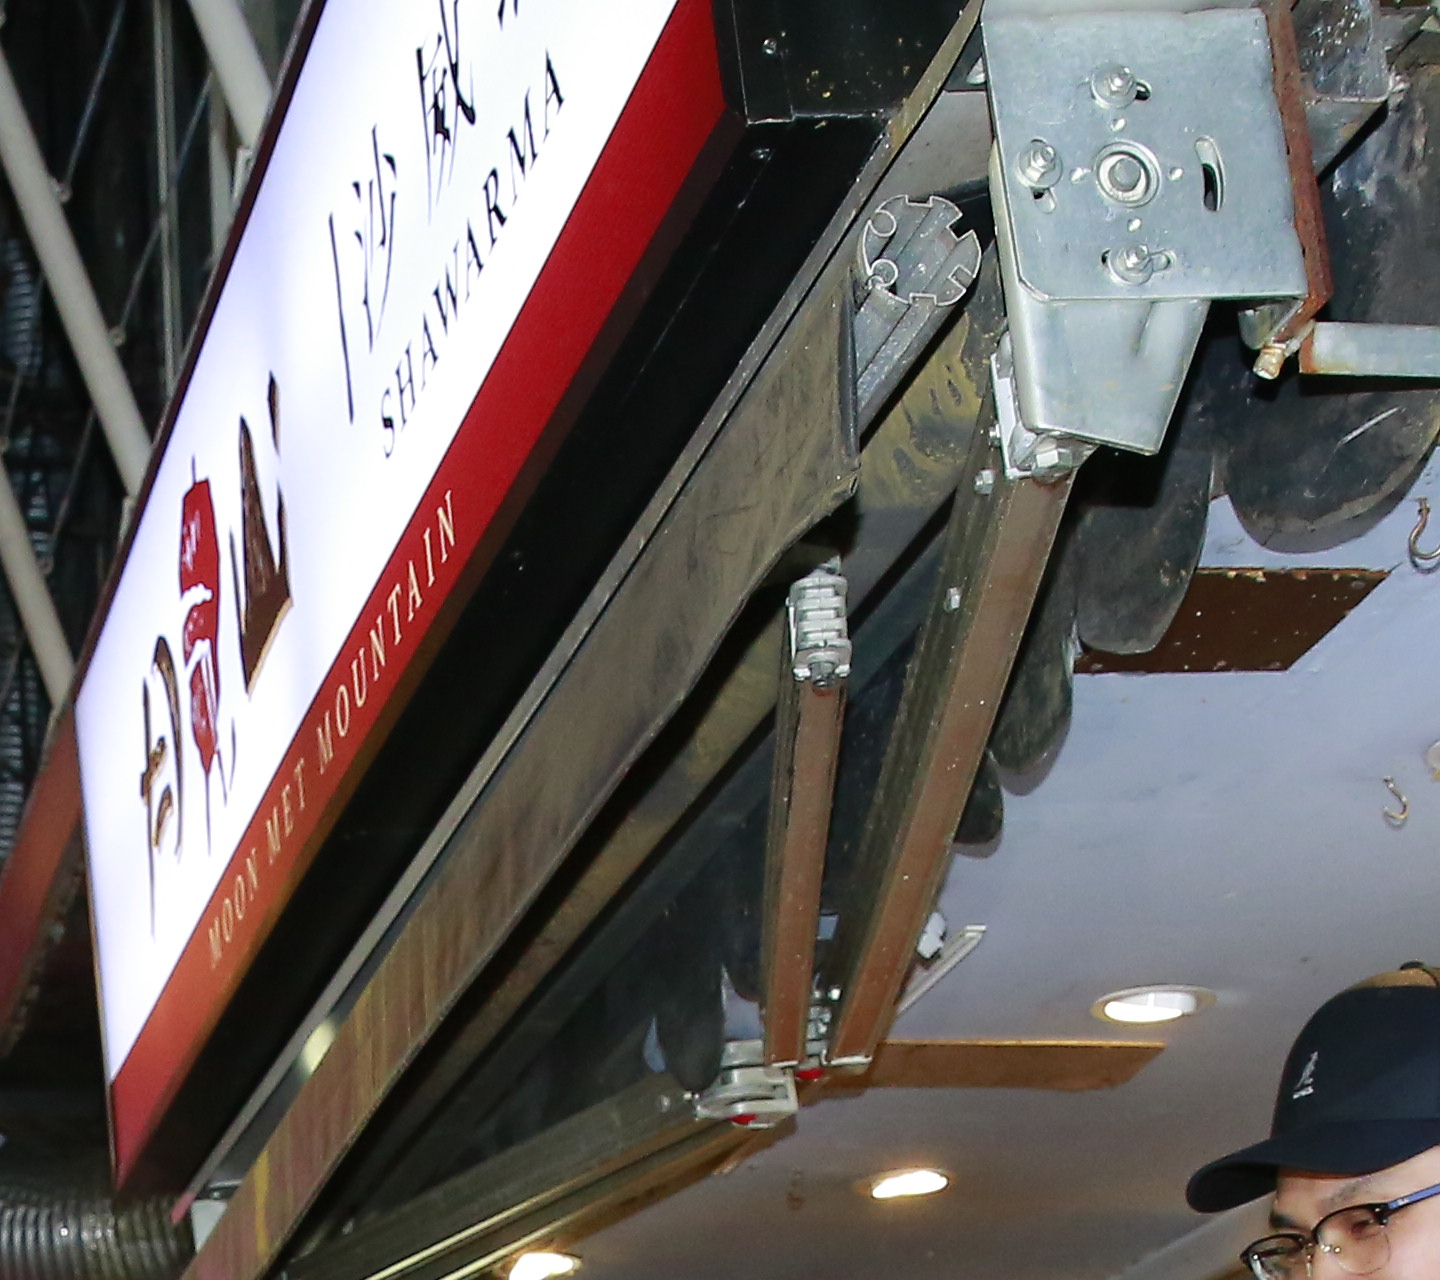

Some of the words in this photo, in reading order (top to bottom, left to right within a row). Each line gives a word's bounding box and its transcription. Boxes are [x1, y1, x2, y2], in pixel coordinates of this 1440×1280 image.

[378, 48, 567, 458] SHAWARMA
[207, 867, 260, 967] MOON
[266, 780, 309, 864] MET
[316, 489, 461, 772] MOUNTAIN
